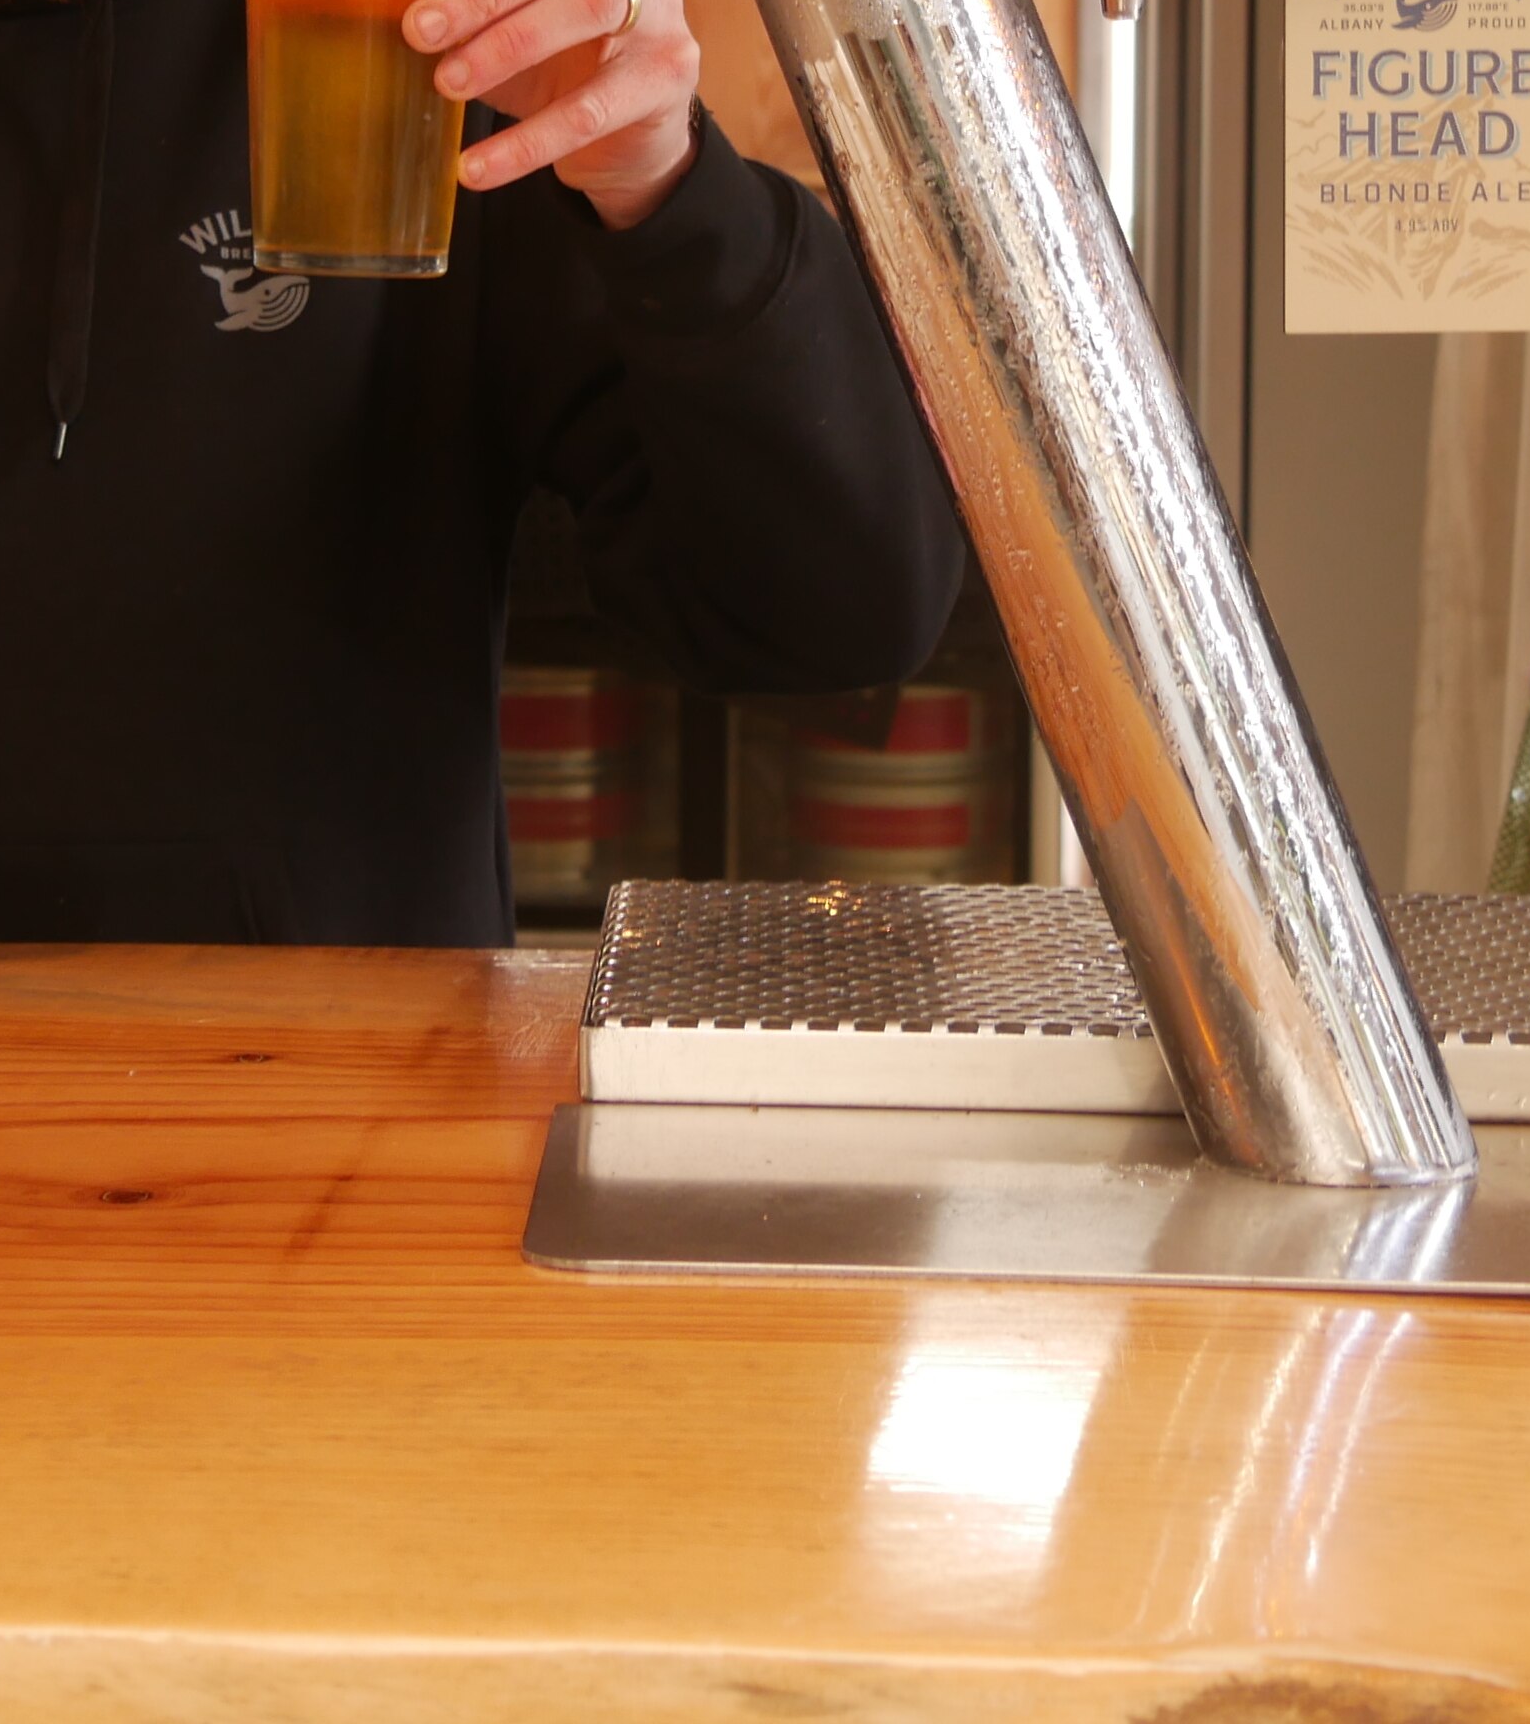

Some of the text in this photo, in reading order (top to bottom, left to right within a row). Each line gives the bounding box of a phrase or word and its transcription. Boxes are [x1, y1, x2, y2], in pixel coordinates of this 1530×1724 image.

[1318, 16, 1528, 32] ALBANY PROUD
[1336, 110, 1523, 163] HEAD
[1319, 181, 1453, 205] BLONDE
[178, 208, 253, 256] WIL
